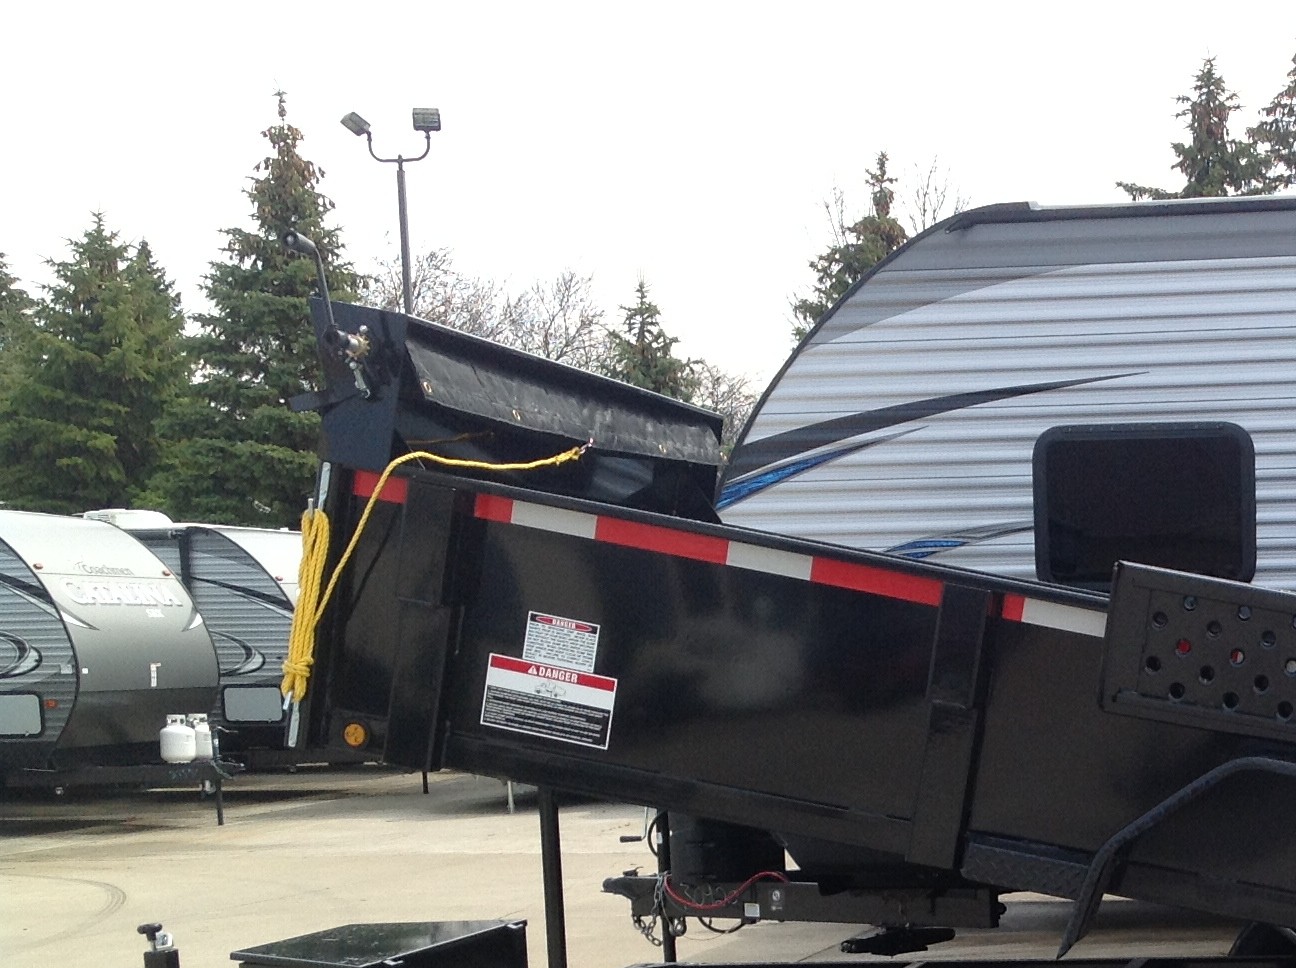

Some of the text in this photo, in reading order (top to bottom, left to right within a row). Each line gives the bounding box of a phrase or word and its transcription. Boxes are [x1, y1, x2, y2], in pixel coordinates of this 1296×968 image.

[60, 577, 184, 607] CATALINA
[552, 618, 576, 629] DANGER
[538, 666, 579, 684] DANGER
